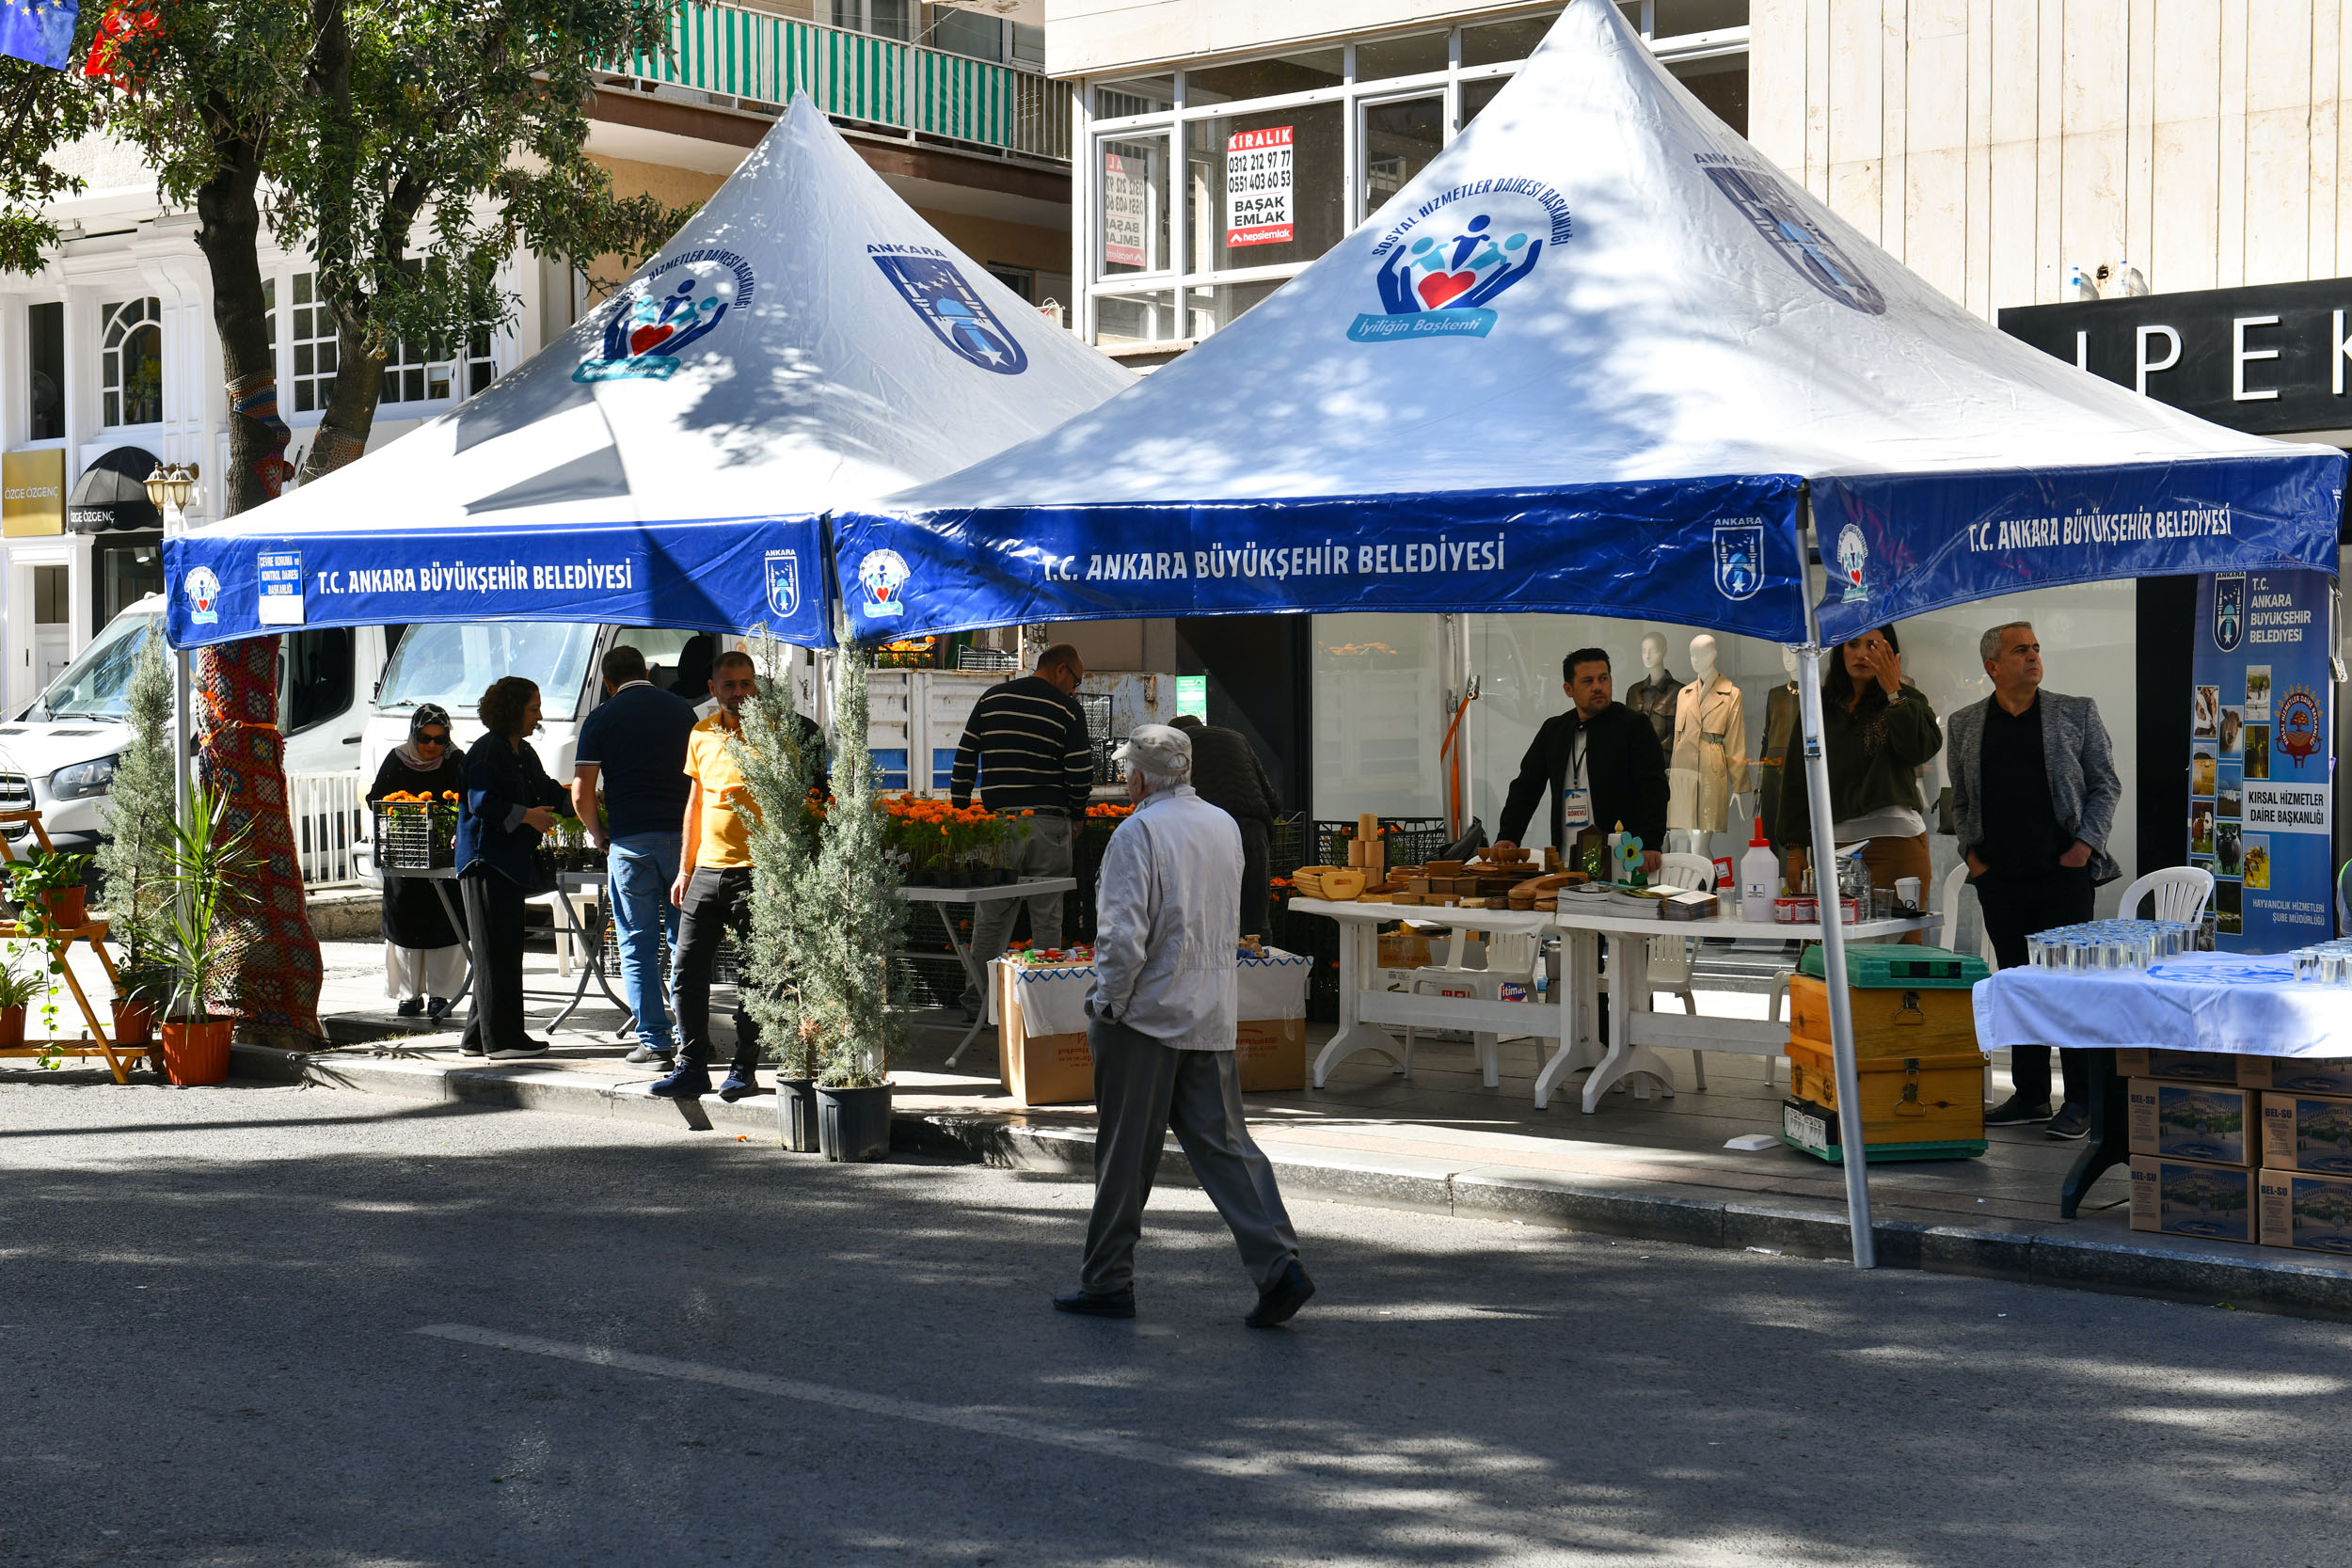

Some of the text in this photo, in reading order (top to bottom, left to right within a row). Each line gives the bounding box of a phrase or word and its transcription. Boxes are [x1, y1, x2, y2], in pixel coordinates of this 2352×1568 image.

[1229, 129, 1290, 150] KİRALIK
[1229, 150, 1291, 173] 0312 212 97 77
[1229, 170, 1291, 193] 0551 403 60 53
[1234, 196, 1284, 213] BAŞAK
[1234, 210, 1285, 227] EMLAK
[1372, 175, 1574, 256] SOSYAL HİZMETLER DAİRESİ BAŞKANLIĞI
[1243, 229, 1290, 243] hepsiemlak
[866, 244, 947, 258] ANKARA
[647, 248, 704, 281] HİZMETLER
[704, 248, 745, 269] DAİRESİ
[732, 261, 755, 310] BAŞKANLIĞI
[1358, 318, 1483, 337] İyiliğin Başkenti
[5, 486, 59, 500] ÖZGE ÖZGENÇ
[83, 511, 115, 524] ÖZGENÇ
[1714, 516, 1763, 527] ANKARA
[1967, 502, 2232, 552] T.C. ANKARA BÜYÜKŞEHİR BELEDİYESİ
[765, 548, 796, 557] ANKARA
[1042, 532, 1505, 581] T.C. ANKARA BÜYÜKŞEHİR BELEDİYESİ
[318, 558, 632, 594] T.C. ANKARA BÜYÜKŞEHİR BELEDİYESİ
[2251, 578, 2269, 591] T.C.
[2250, 594, 2293, 609] ANKARA
[2250, 610, 2312, 626] BÜYÜKŞEHİR
[2249, 628, 2302, 643] BELEDİYESİ
[2249, 789, 2324, 807] KIRSAL HİZMETLER
[2250, 807, 2324, 827] DAİRE BAŞKANLIĞI
[2252, 898, 2325, 912] HAYVANCILIK HİZMETLERİ
[2272, 912, 2325, 926] ŞUBE MÜDÜRLÜĞÜ
[2131, 1094, 2155, 1105] BEL-SU
[2265, 1108, 2293, 1119] BEL-SU
[2131, 1171, 2157, 1181] BEL-SU
[2261, 1185, 2288, 1196] BEL-SU
